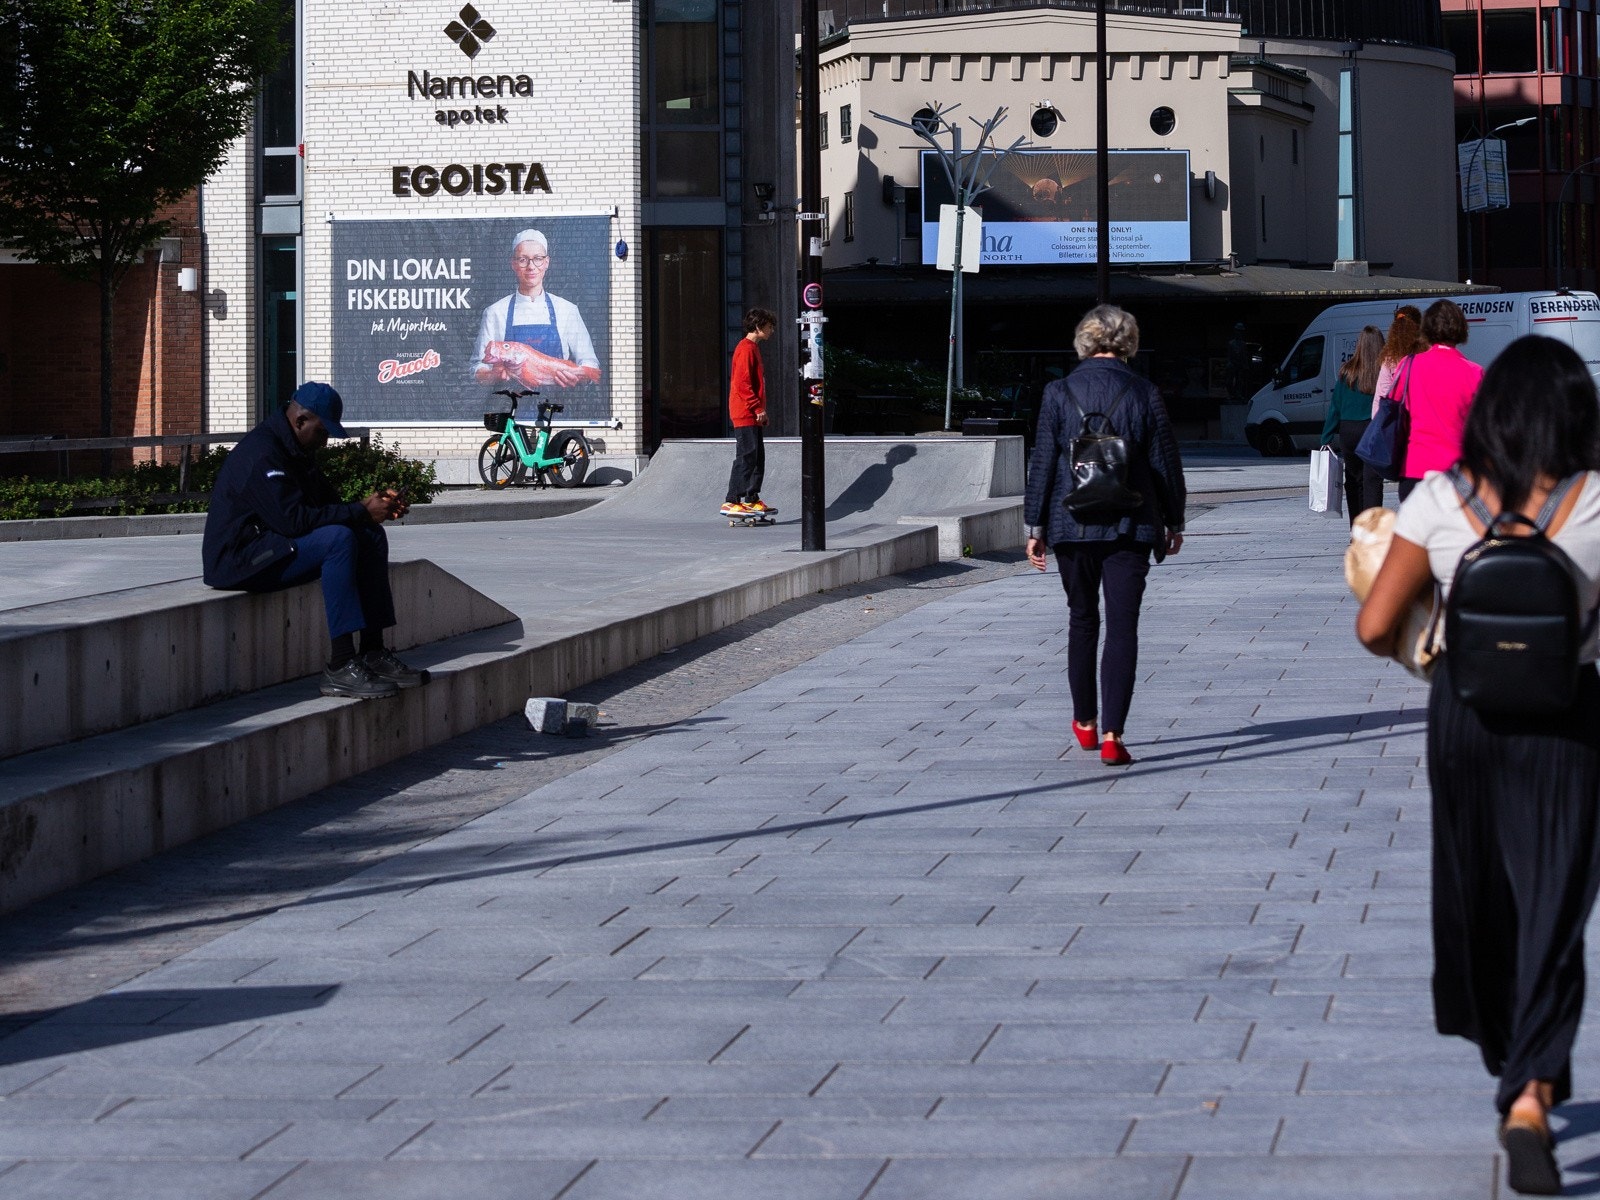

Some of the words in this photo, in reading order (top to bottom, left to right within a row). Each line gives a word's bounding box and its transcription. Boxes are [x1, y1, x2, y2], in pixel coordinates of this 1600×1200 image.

[407, 69, 534, 101] Namena
[434, 105, 510, 129] apotek
[392, 162, 553, 197] EGOISTA
[1063, 235, 1087, 243] Norges
[1135, 234, 1143, 242] på
[1058, 251, 1084, 259] Billetter
[346, 258, 386, 281] DIN
[393, 257, 472, 281] LOKALE
[347, 287, 472, 311] FISKEBUTIKK
[1530, 298, 1600, 314] BERENDSEN
[371, 318, 386, 336] på
[387, 316, 448, 340] Majorstuen
[377, 348, 441, 384] Jacob's
